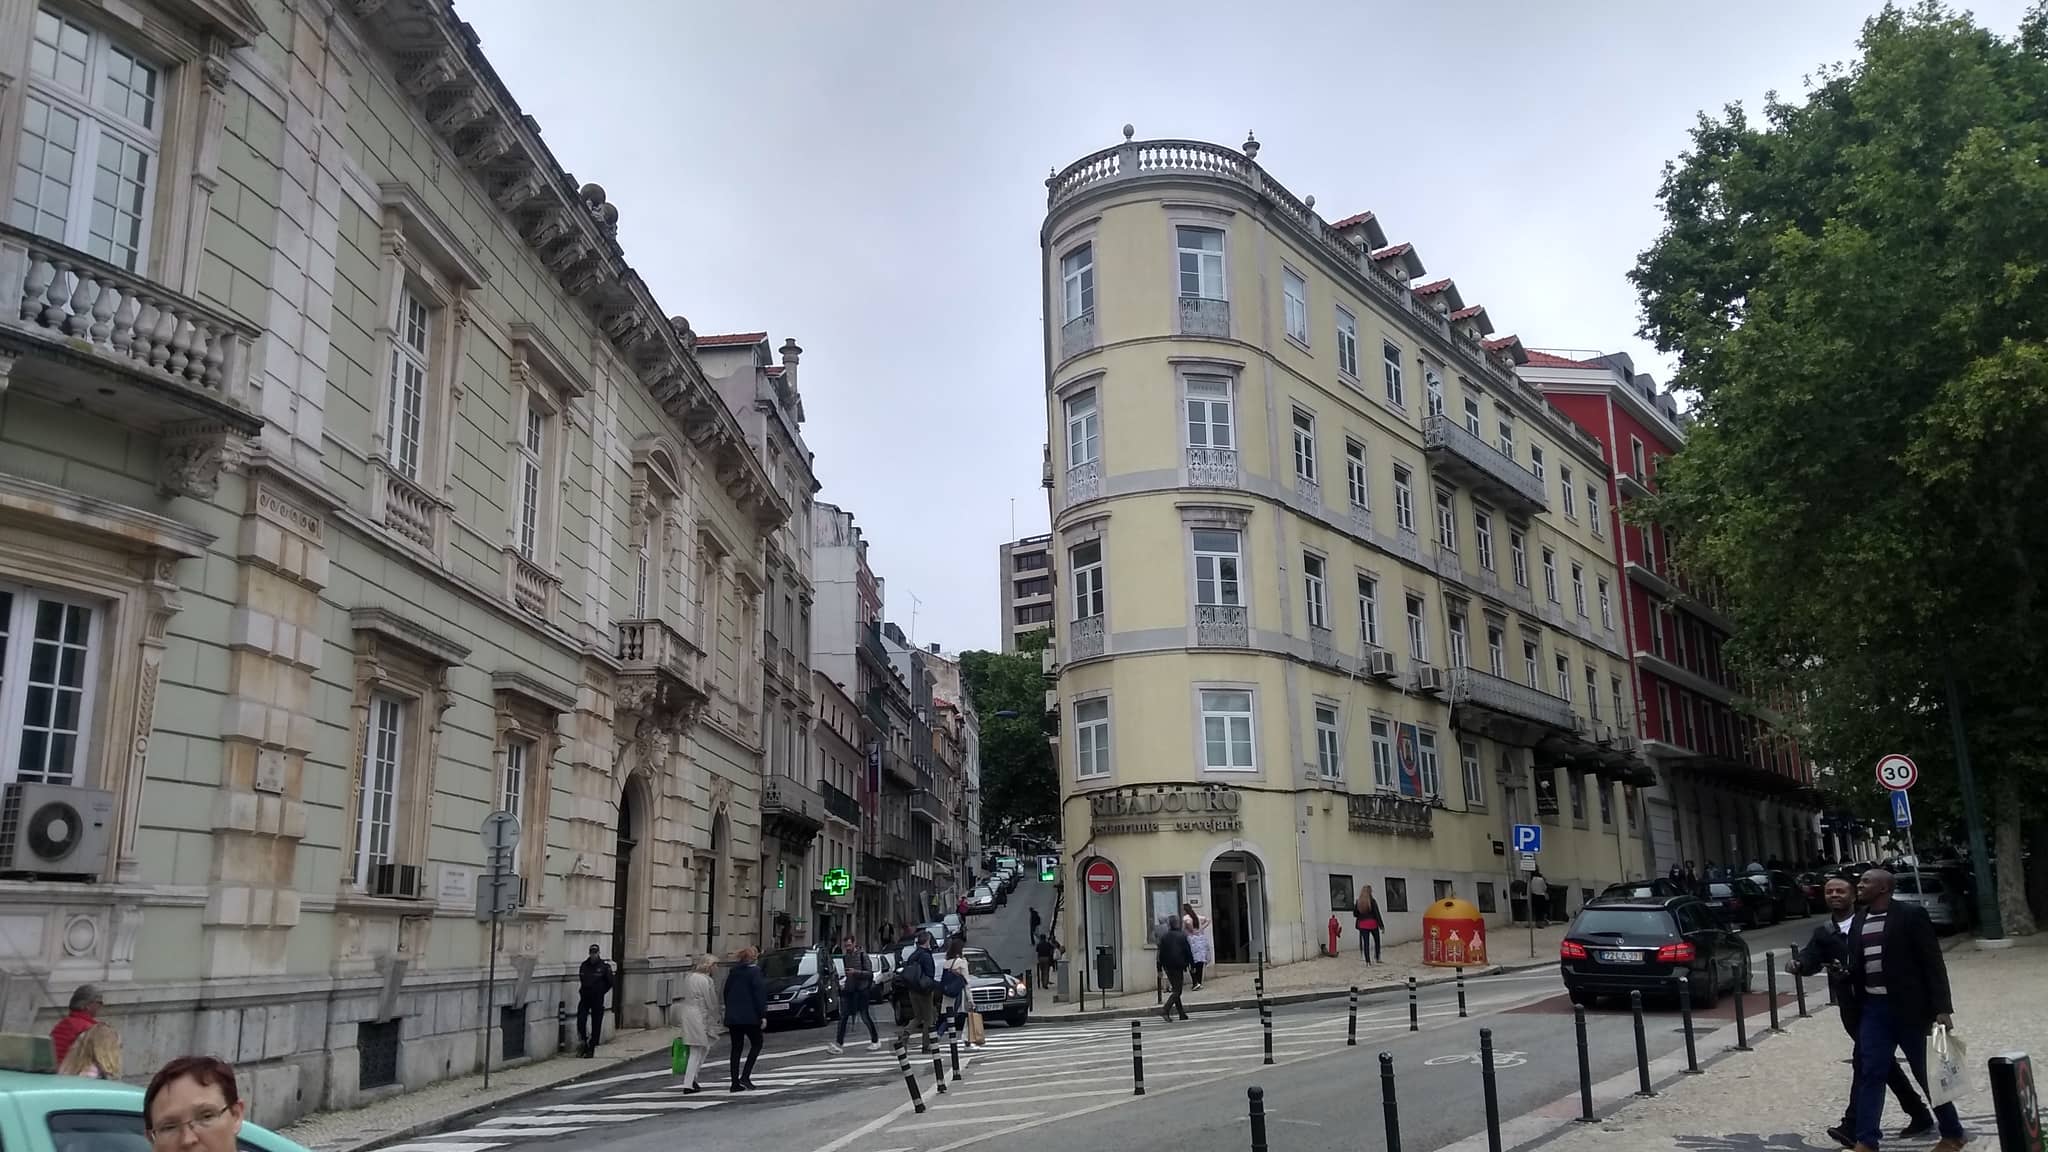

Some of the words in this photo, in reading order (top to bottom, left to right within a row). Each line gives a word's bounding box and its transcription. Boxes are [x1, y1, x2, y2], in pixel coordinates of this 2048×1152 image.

[1884, 766, 1909, 780] 30
[1090, 790, 1242, 816] RIBADOURO
[1520, 828, 1536, 849] P
